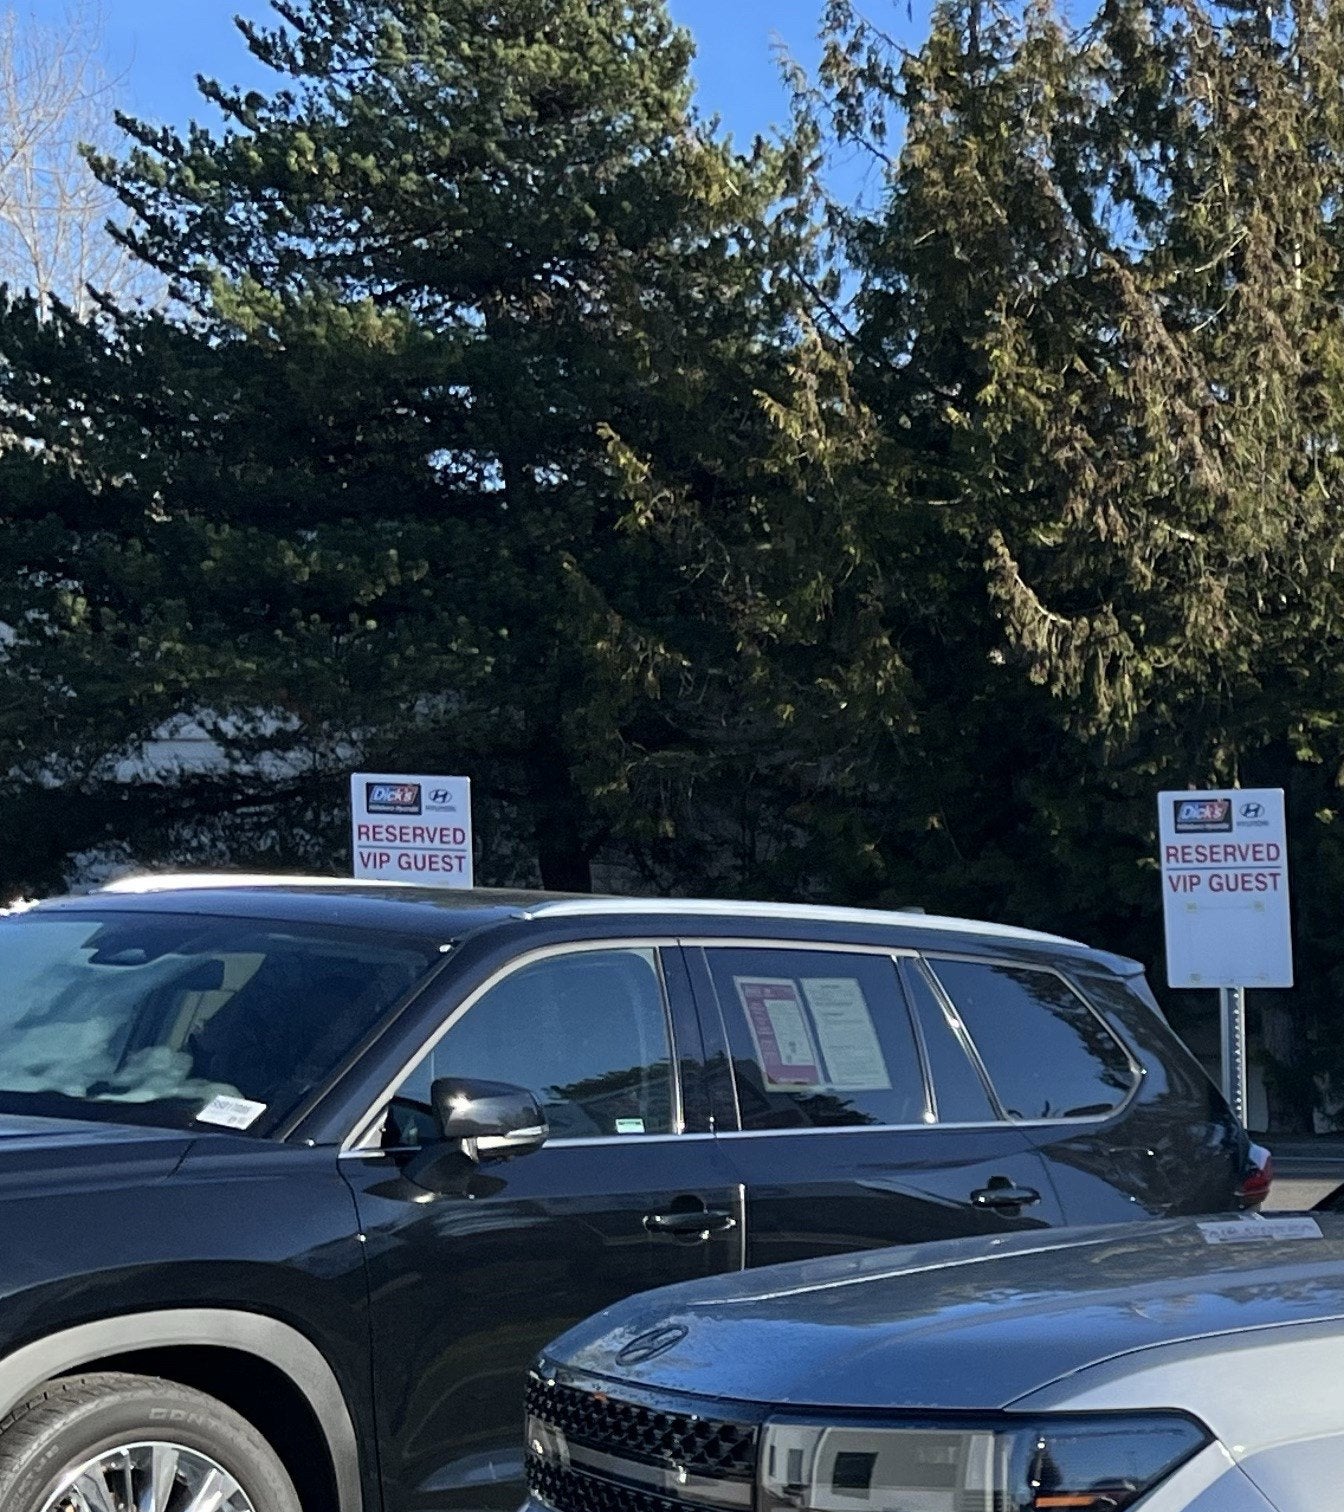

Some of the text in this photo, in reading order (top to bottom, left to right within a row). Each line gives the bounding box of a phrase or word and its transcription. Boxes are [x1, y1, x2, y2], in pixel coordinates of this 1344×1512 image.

[357, 824, 466, 845] RESERVED
[359, 851, 466, 873] VIP GUEST
[1166, 843, 1280, 863] RESERVED
[1168, 873, 1280, 892] VIP GUEST
